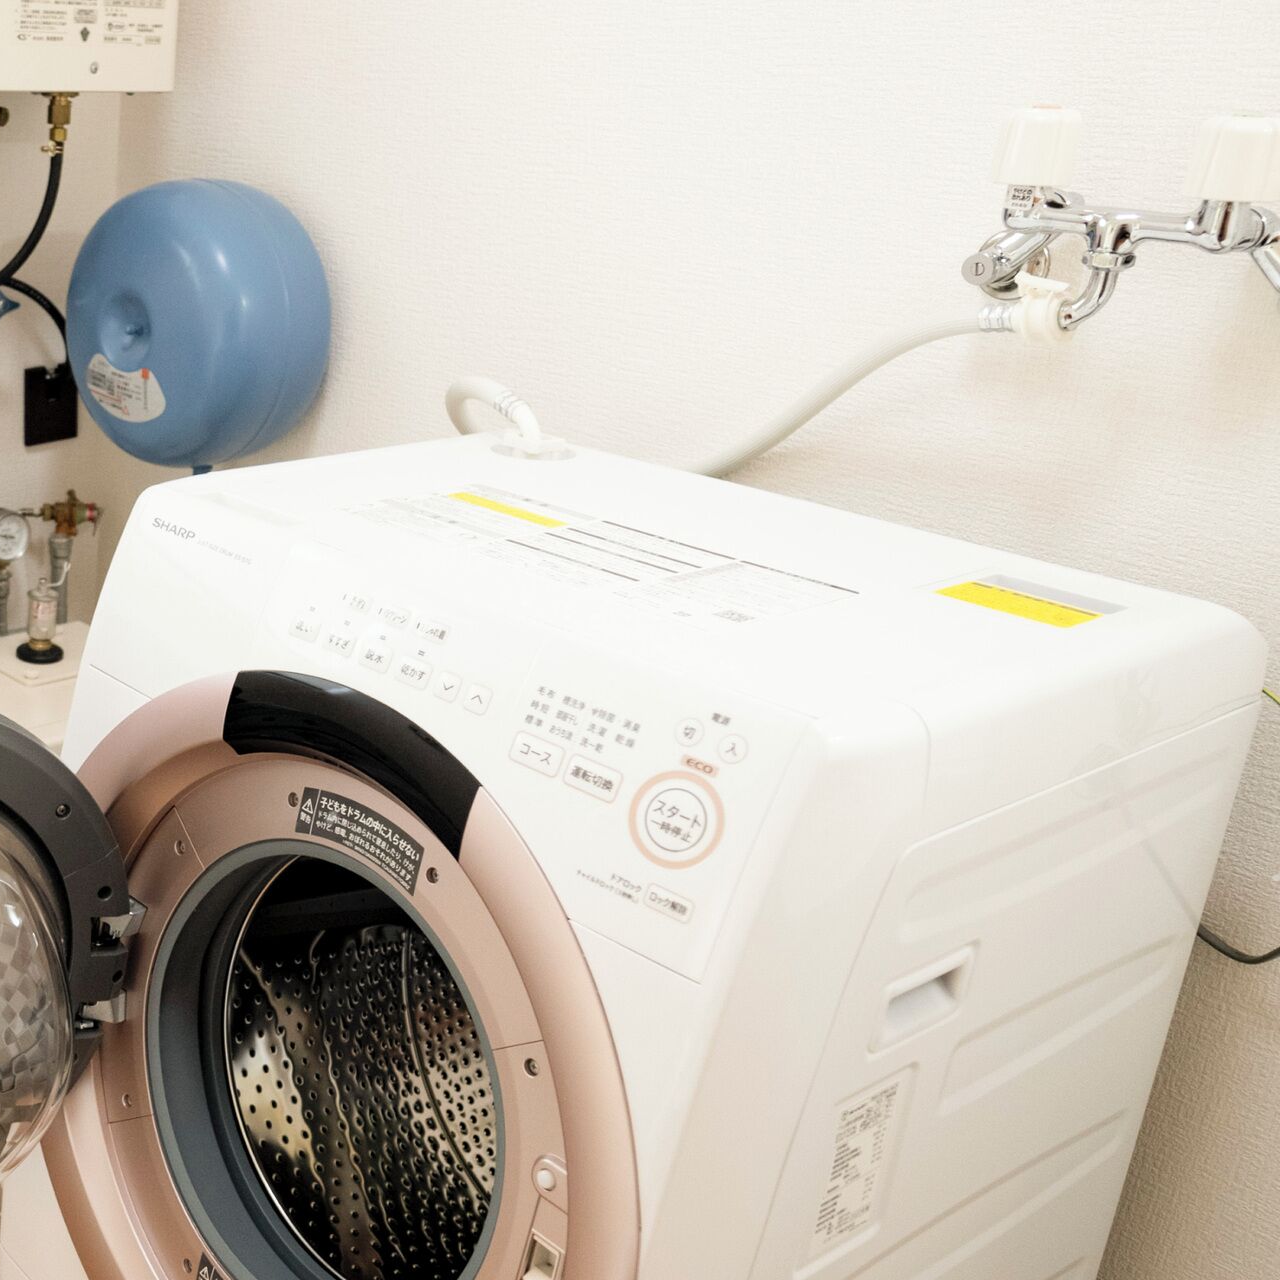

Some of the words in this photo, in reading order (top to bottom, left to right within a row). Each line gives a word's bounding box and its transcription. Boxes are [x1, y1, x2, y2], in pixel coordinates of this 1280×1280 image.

[974, 262, 985, 276] D
[151, 517, 196, 540] SHARP
[400, 663, 425, 681] 乾かす
[537, 685, 556, 699] 毛布
[683, 725, 697, 739] 切
[519, 742, 552, 766] コース
[724, 742, 738, 757] 入
[570, 765, 614, 793] 運転切換
[299, 811, 312, 825] 警告
[653, 800, 702, 829] スタート
[319, 796, 420, 861] 子どもをドラムの中に入らせない
[650, 819, 692, 843] 一時停止
[648, 891, 689, 916] ロック解除
